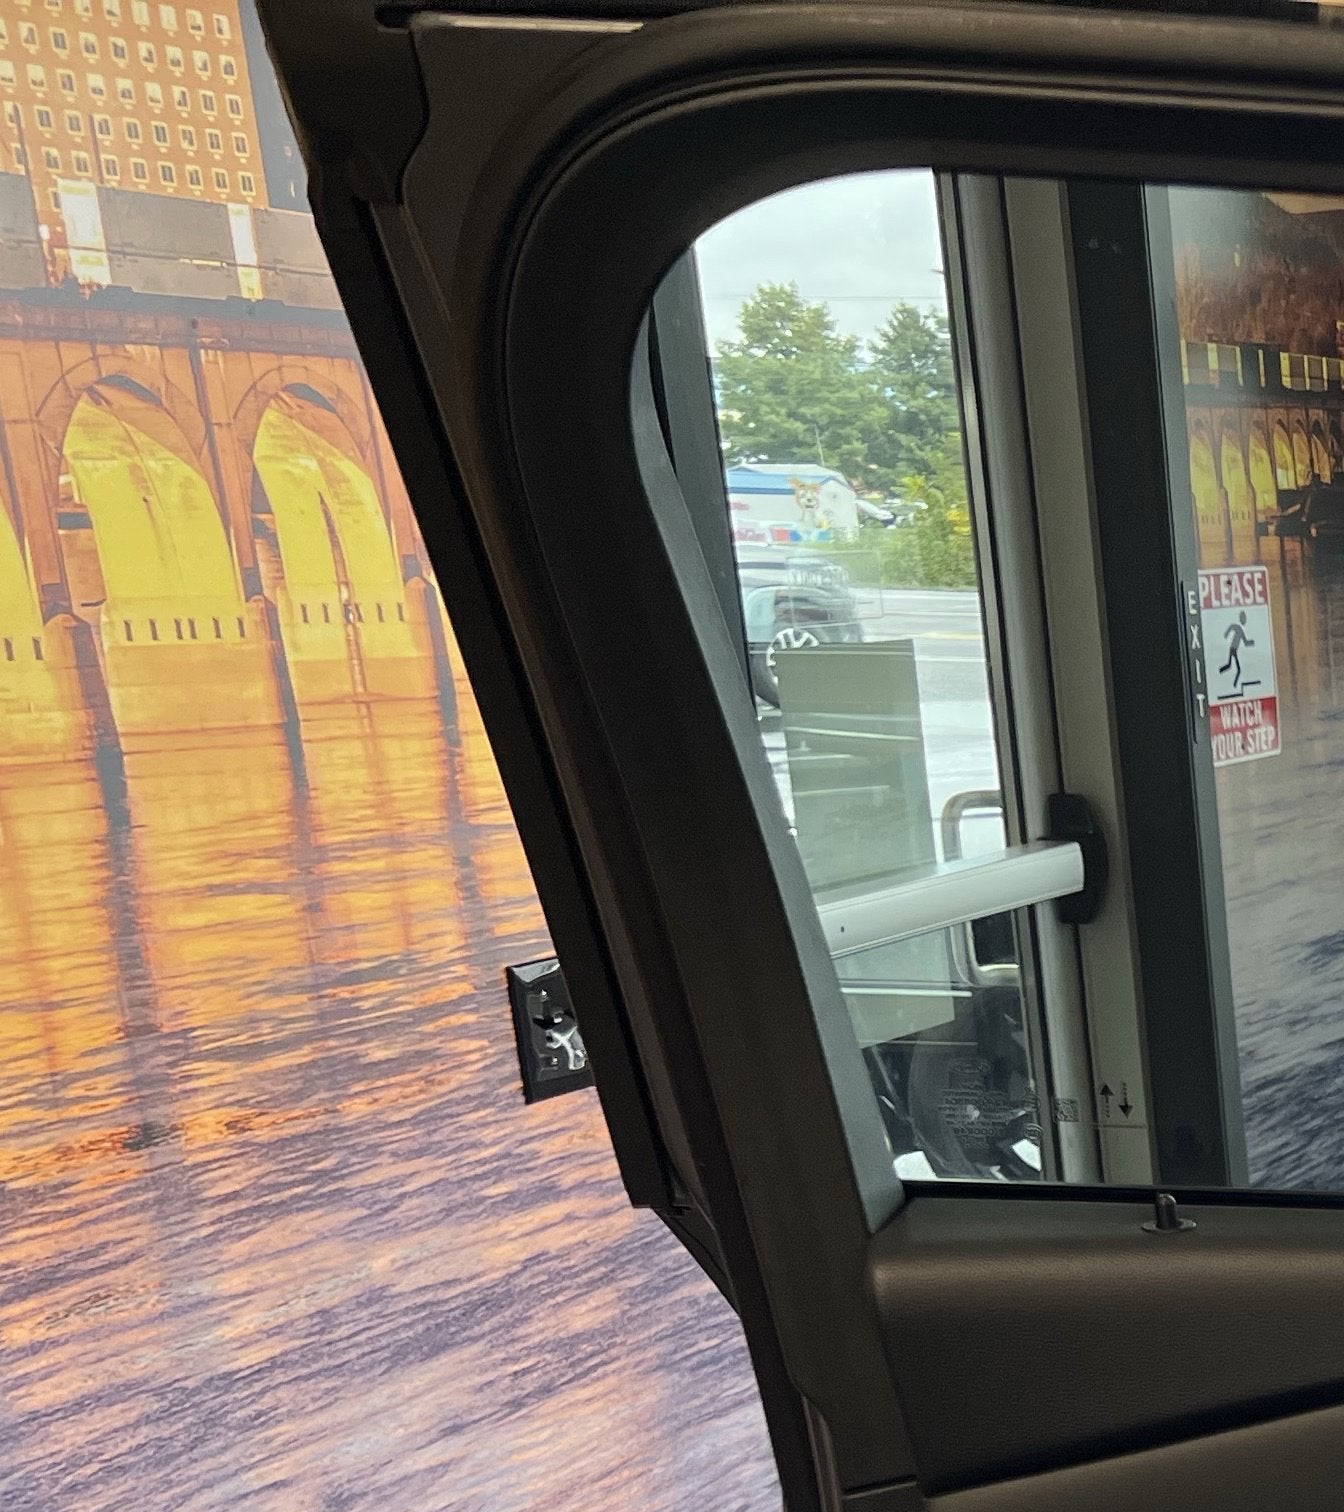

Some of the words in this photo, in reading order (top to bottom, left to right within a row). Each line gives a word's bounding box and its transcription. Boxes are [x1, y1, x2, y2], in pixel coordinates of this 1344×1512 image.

[1200, 572, 1265, 608] PLEASE
[1187, 591, 1205, 718] EXIT
[1219, 699, 1263, 730] WATCH
[1211, 731, 1244, 761] YOUR
[1247, 726, 1276, 754] STEP
